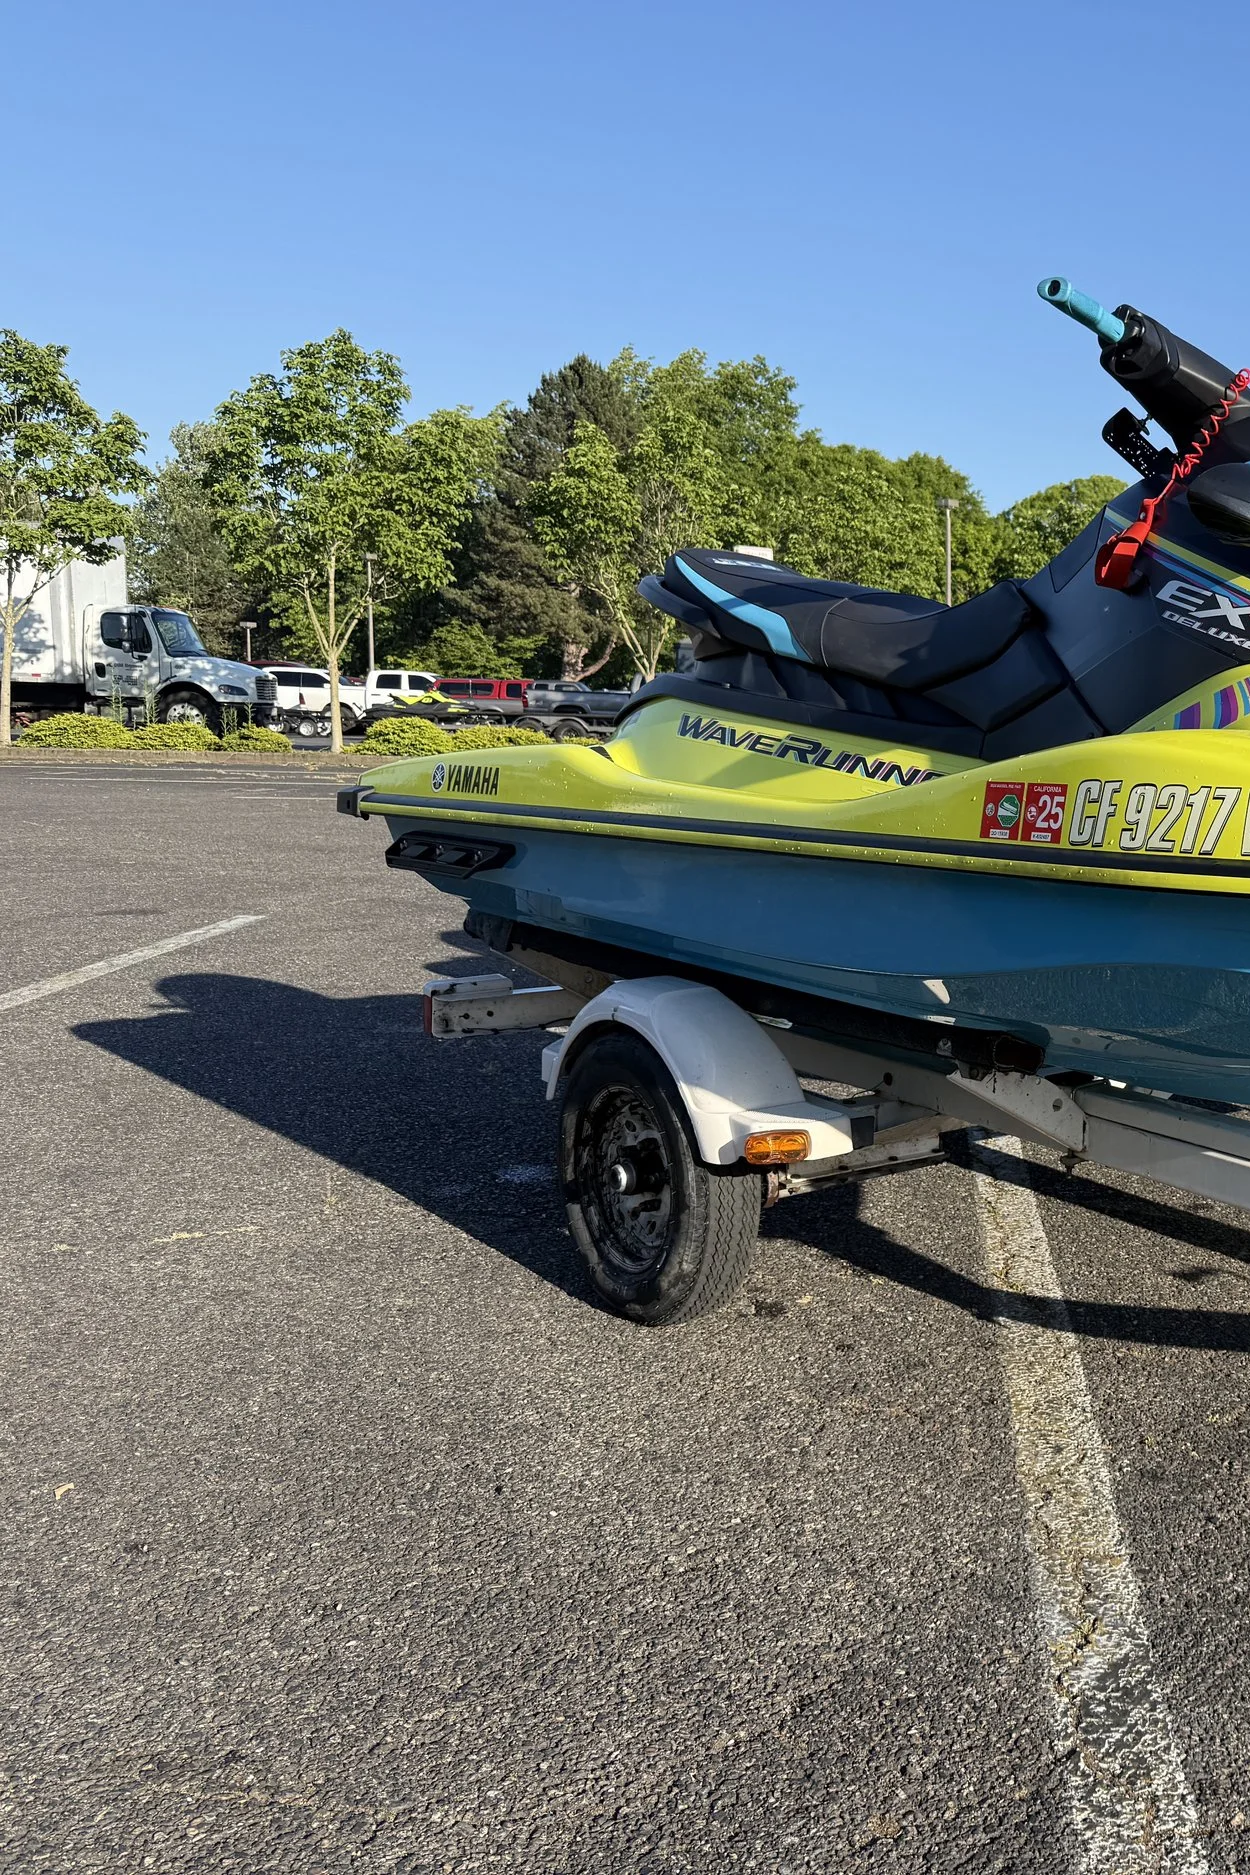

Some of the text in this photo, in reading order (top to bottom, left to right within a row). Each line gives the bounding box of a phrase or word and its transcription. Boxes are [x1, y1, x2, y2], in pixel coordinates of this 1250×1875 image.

[446, 764, 500, 796] YAMAHA
[1033, 785, 1062, 793] CALIFORNIA
[1035, 794, 1065, 830] 25
[1068, 778, 1123, 848] CF
[1118, 783, 1242, 854] 9217
